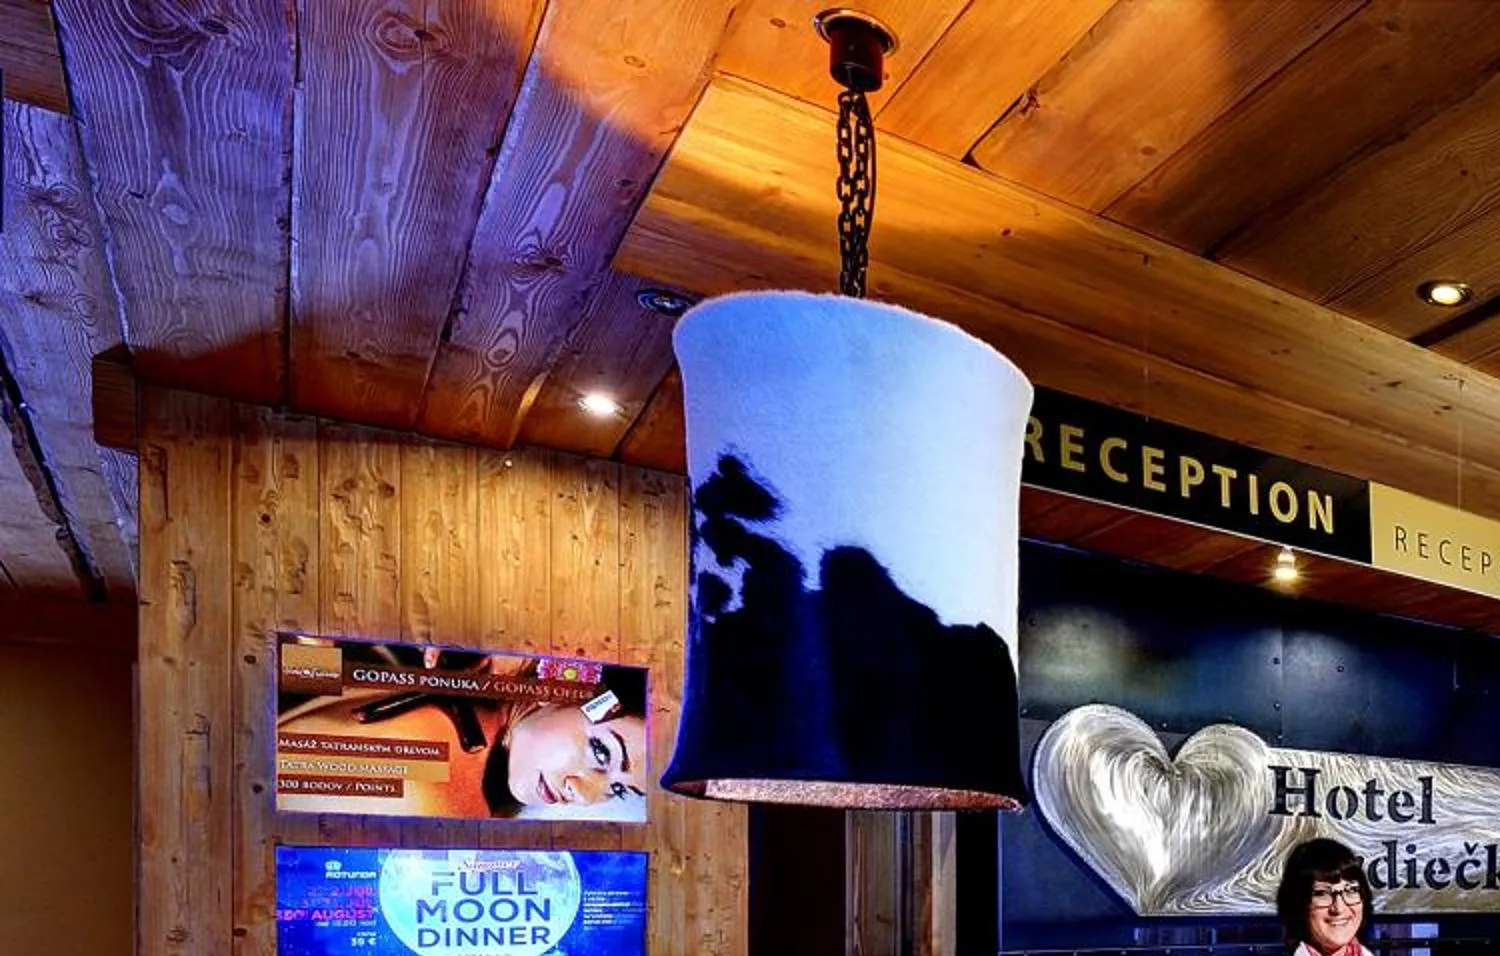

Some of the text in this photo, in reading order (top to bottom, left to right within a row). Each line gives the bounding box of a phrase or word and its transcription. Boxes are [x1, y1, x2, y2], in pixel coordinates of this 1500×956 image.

[1024, 416, 1334, 534] RECEPTION
[353, 668, 416, 685] GOPASS
[419, 675, 479, 691] PONUKA
[493, 681, 550, 696] GOPASS
[1268, 765, 1437, 825] Hotel
[431, 871, 539, 897] FULL
[311, 908, 374, 921] AUGUST
[416, 897, 551, 924] MOON
[417, 925, 551, 949] DINNER
